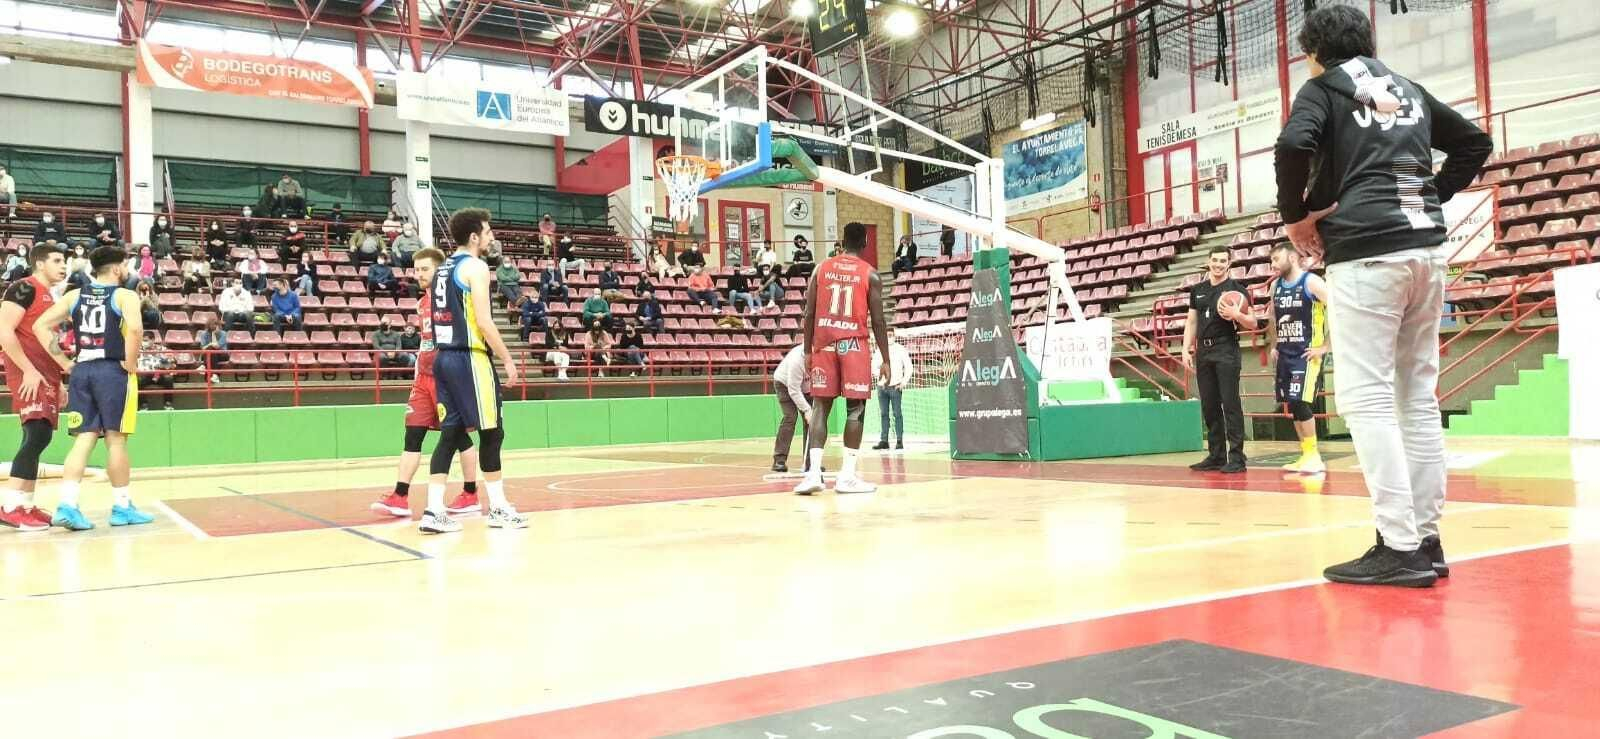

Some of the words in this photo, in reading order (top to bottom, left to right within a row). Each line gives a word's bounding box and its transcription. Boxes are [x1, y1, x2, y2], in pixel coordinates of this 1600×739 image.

[203, 57, 333, 83] BODEGOTRANS
[516, 95, 562, 108] Universidad
[1012, 143, 1020, 154] EL
[1021, 126, 1073, 152] AYUNTAMIENTO
[1161, 119, 1181, 134] SALA
[1035, 135, 1084, 158] TORRELAVEGA
[824, 271, 850, 283] WALTER
[434, 276, 447, 308] 9
[822, 283, 853, 318] 11
[1279, 295, 1293, 308] 30
[79, 304, 106, 333] 10
[961, 356, 1017, 386] AlegA
[763, 681, 1036, 739] QUALITY
